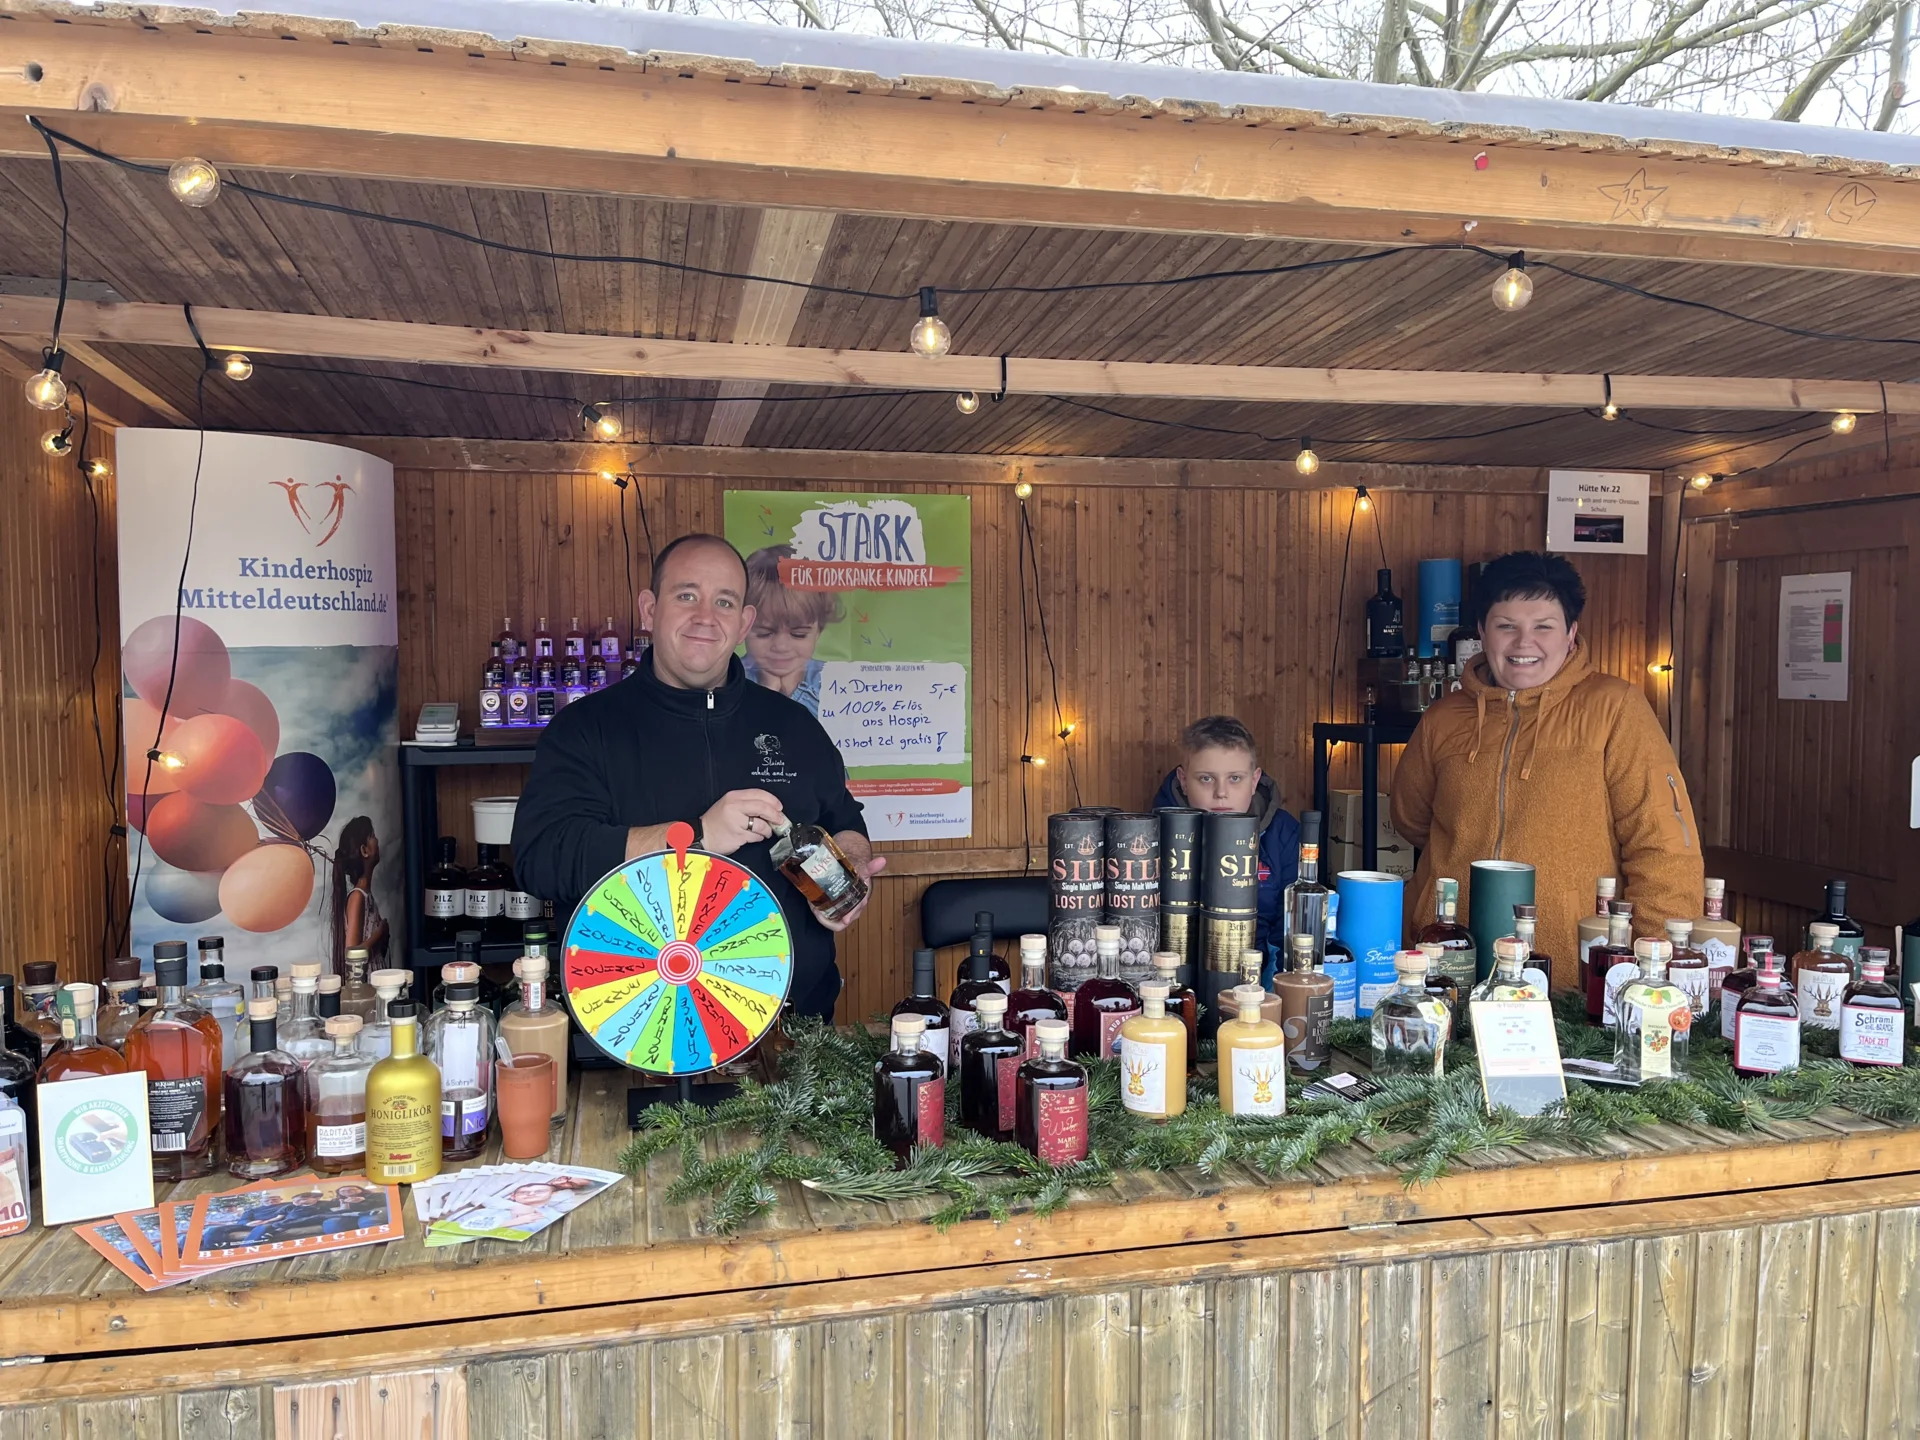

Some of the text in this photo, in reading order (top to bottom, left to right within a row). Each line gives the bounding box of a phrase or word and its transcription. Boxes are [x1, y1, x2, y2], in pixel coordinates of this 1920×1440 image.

[1578, 484, 1621, 494] Hütte Nr.22
[817, 512, 915, 562] STARK
[238, 557, 373, 588] Kinderhospiz
[790, 565, 933, 587] FÜR TODKRANKE KINDER!
[176, 587, 387, 613] Mitteldeutschland.de
[828, 679, 848, 695] 1x
[848, 679, 903, 694] Drehen
[822, 700, 923, 718] zu 100% Erlös
[888, 714, 932, 729] Hospiz
[909, 817, 966, 825] Mitteldeutschland.de
[1061, 882, 1079, 892] Single
[1079, 882, 1092, 891] Malt
[1114, 881, 1131, 892] Single
[1131, 882, 1144, 891] Malt
[434, 894, 453, 903] PILZ
[469, 894, 486, 903] PILZ
[510, 896, 529, 905] PILZ
[692, 869, 732, 934] CHANCE
[1055, 894, 1084, 910] LOST
[1108, 893, 1136, 909] LOST
[602, 888, 660, 943] CHANCE
[1855, 1012, 1894, 1027] Schraml
[681, 997, 700, 1066] CHANCE
[1858, 1035, 1876, 1046] STADE
[73, 1100, 130, 1119] WIR AKZEPTIEREN
[370, 1103, 432, 1120] HONIGLIKÖR
[198, 1223, 391, 1259] BENEFICUS
